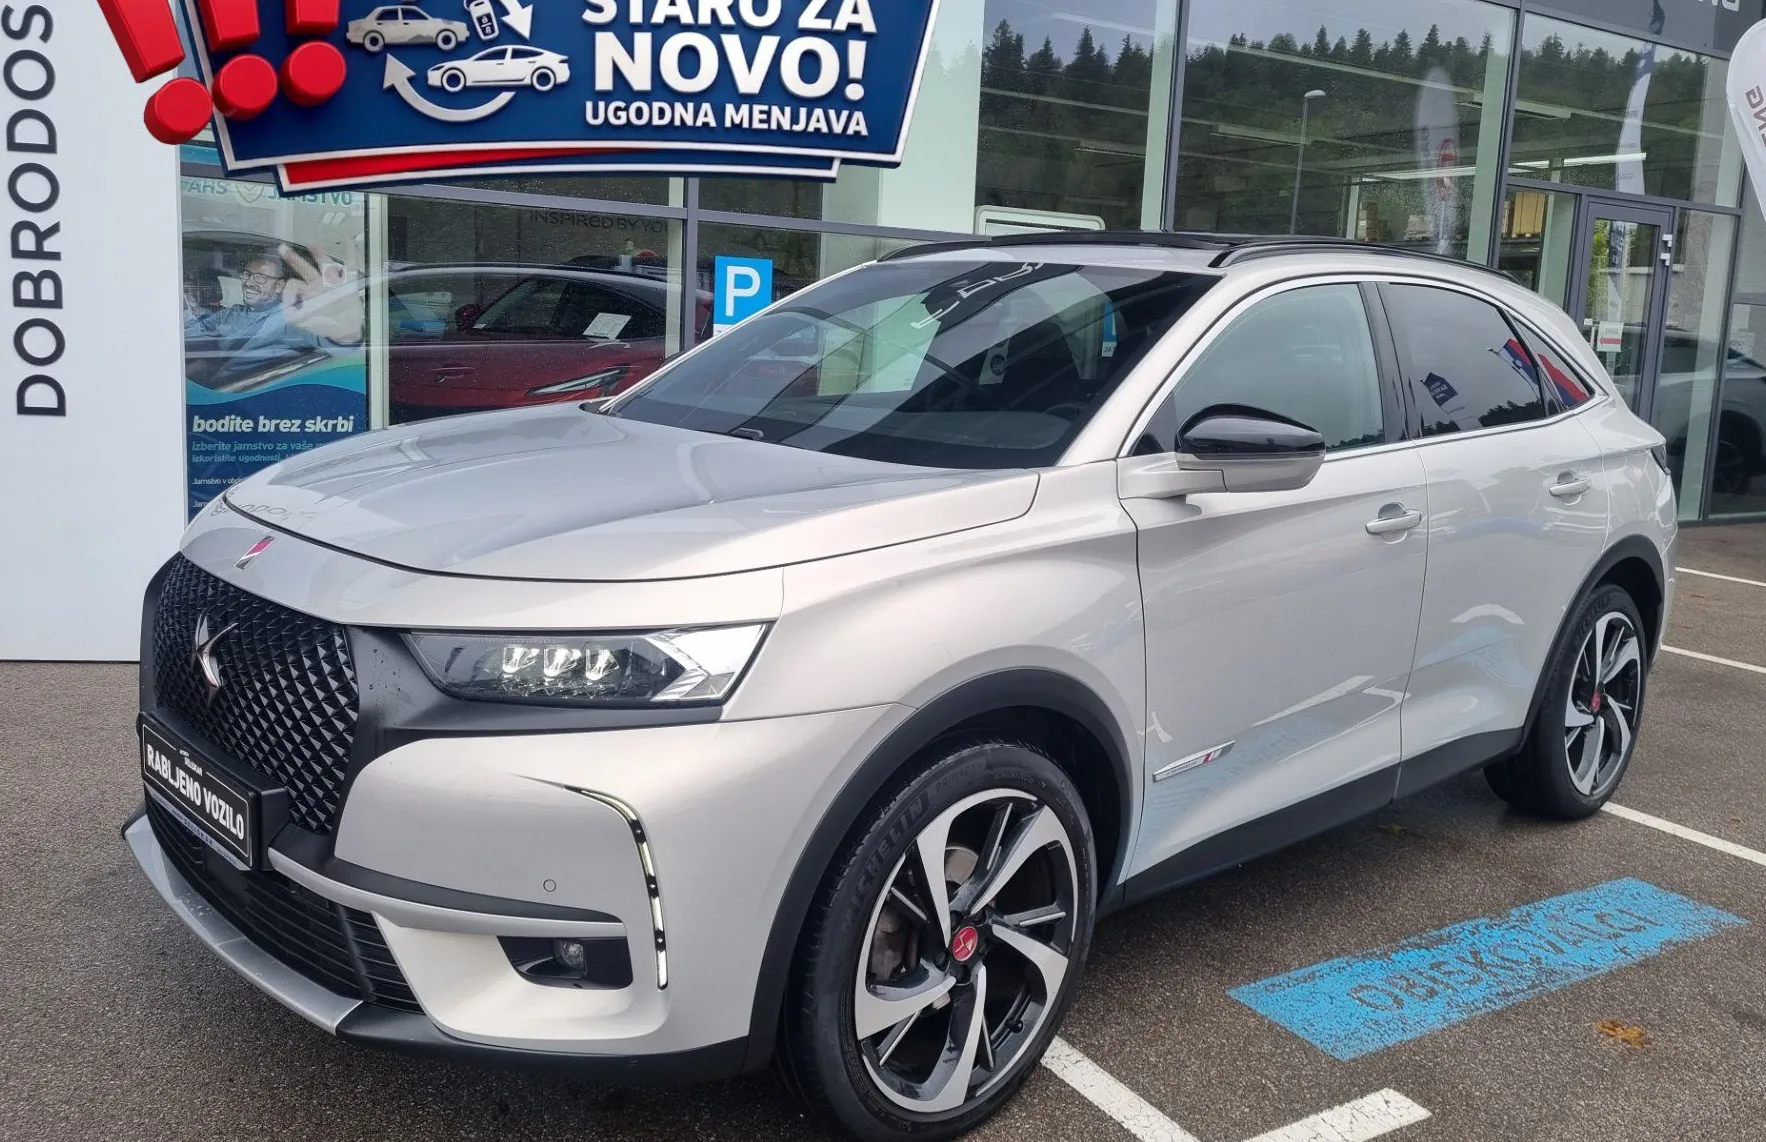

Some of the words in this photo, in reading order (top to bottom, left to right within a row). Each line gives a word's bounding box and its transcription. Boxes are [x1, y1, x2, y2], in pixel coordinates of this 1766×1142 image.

[616, 218, 640, 231] BY
[726, 265, 760, 317] P
[192, 415, 254, 433] bodite
[258, 416, 301, 433] brez
[304, 416, 354, 433] skrbi
[233, 441, 274, 453] jamstvo
[276, 443, 288, 451] za
[290, 440, 313, 450] vaše
[147, 743, 202, 807] RABLJENO
[203, 786, 245, 840] VOZILO
